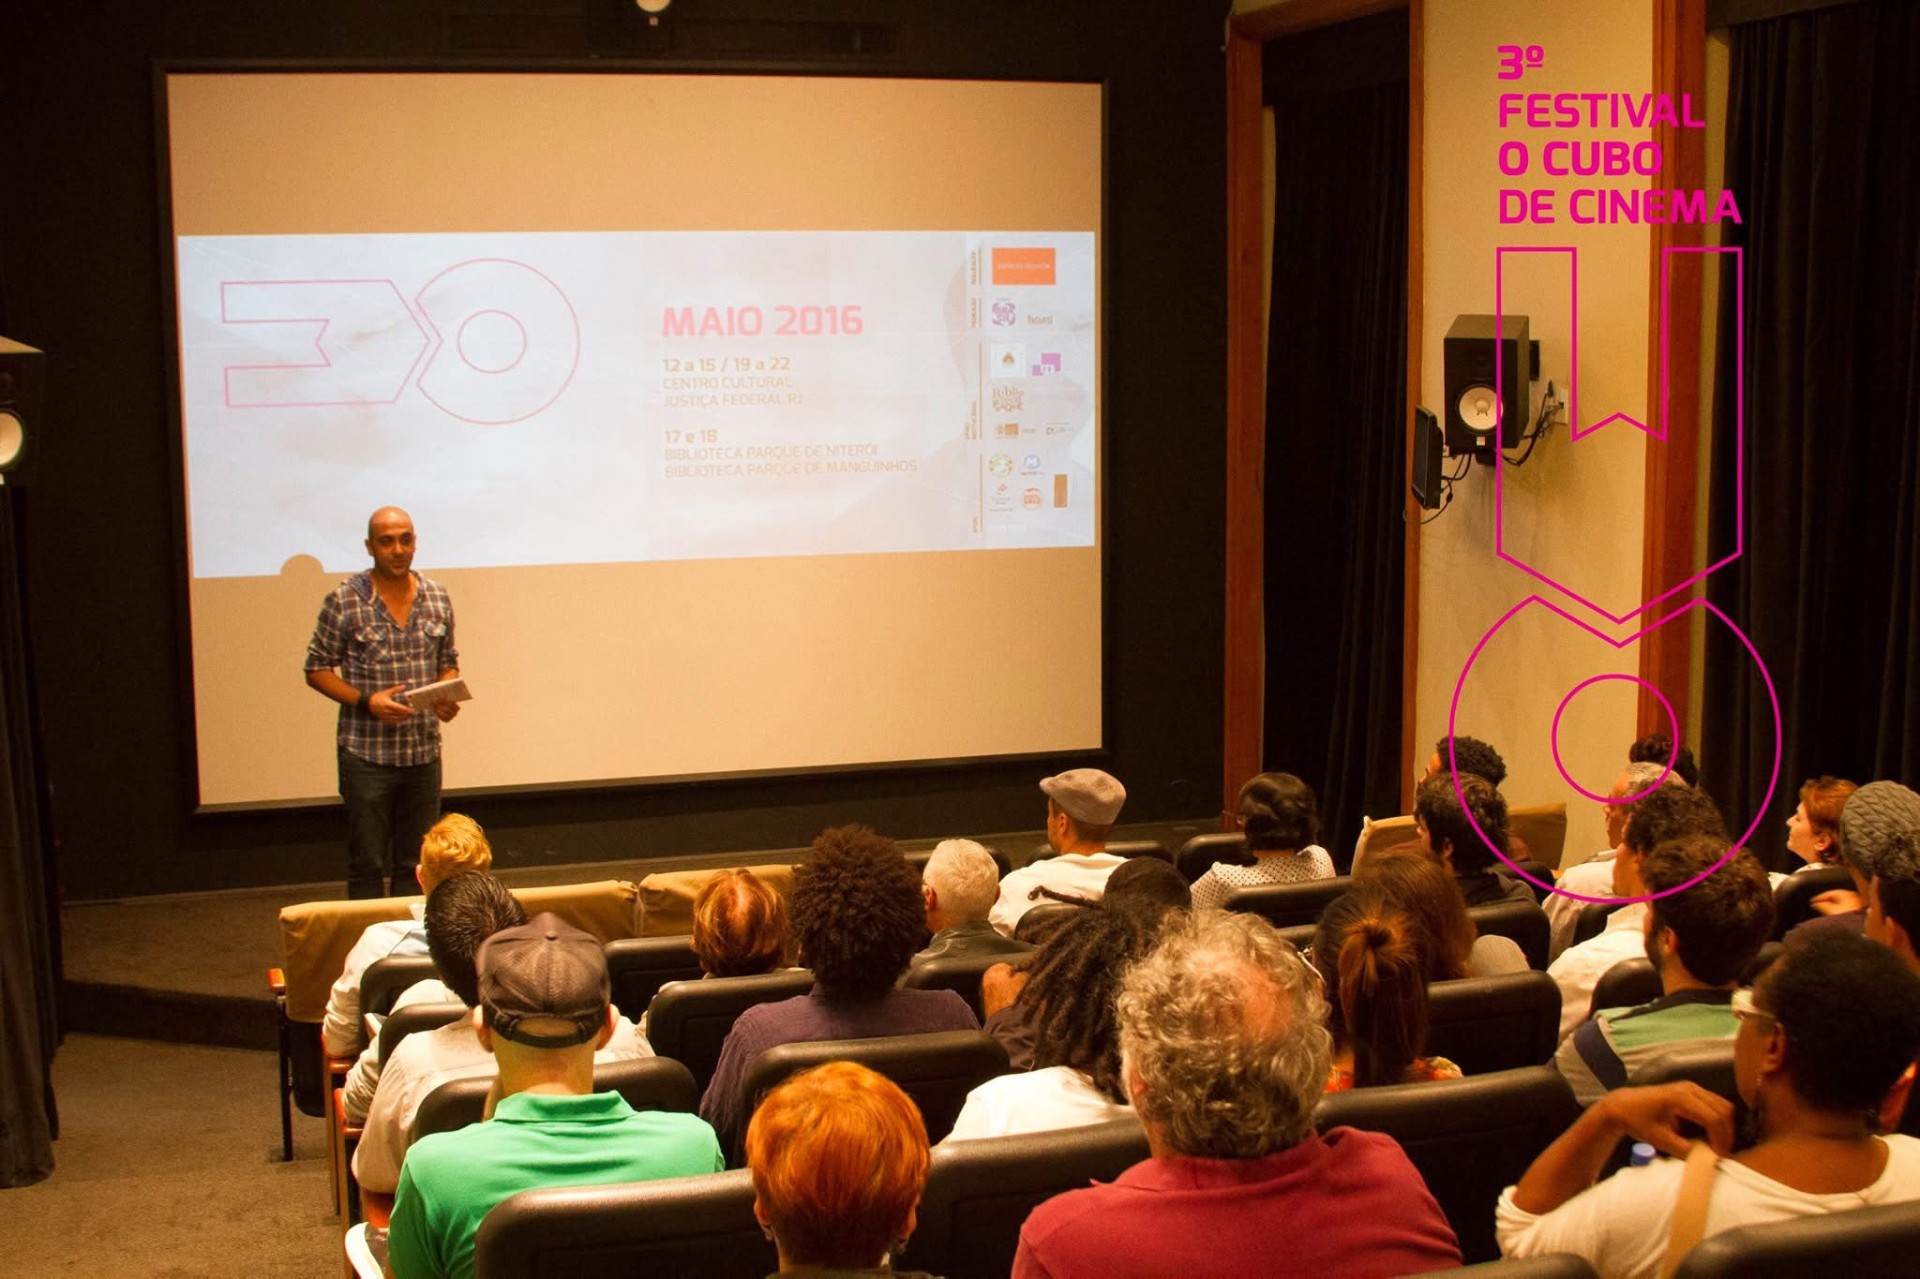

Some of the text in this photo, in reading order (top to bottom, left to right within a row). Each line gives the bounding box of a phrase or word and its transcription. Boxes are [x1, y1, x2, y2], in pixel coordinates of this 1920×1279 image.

[662, 304, 865, 337] MAIO 2016
[663, 356, 791, 373] 12 a 15 / 19 a 22
[663, 375, 793, 390] CENTRO CULTURAL
[663, 394, 719, 409] JUSTIÇA
[722, 392, 783, 406] FEDERAL
[664, 429, 717, 443] 17 e 18
[665, 446, 743, 461] BIBLIOTECA
[747, 445, 801, 460] PARQUE
[804, 444, 822, 457] DE
[665, 459, 918, 478] BIBLIOTECA PARQUE DE MANGUINHOS
